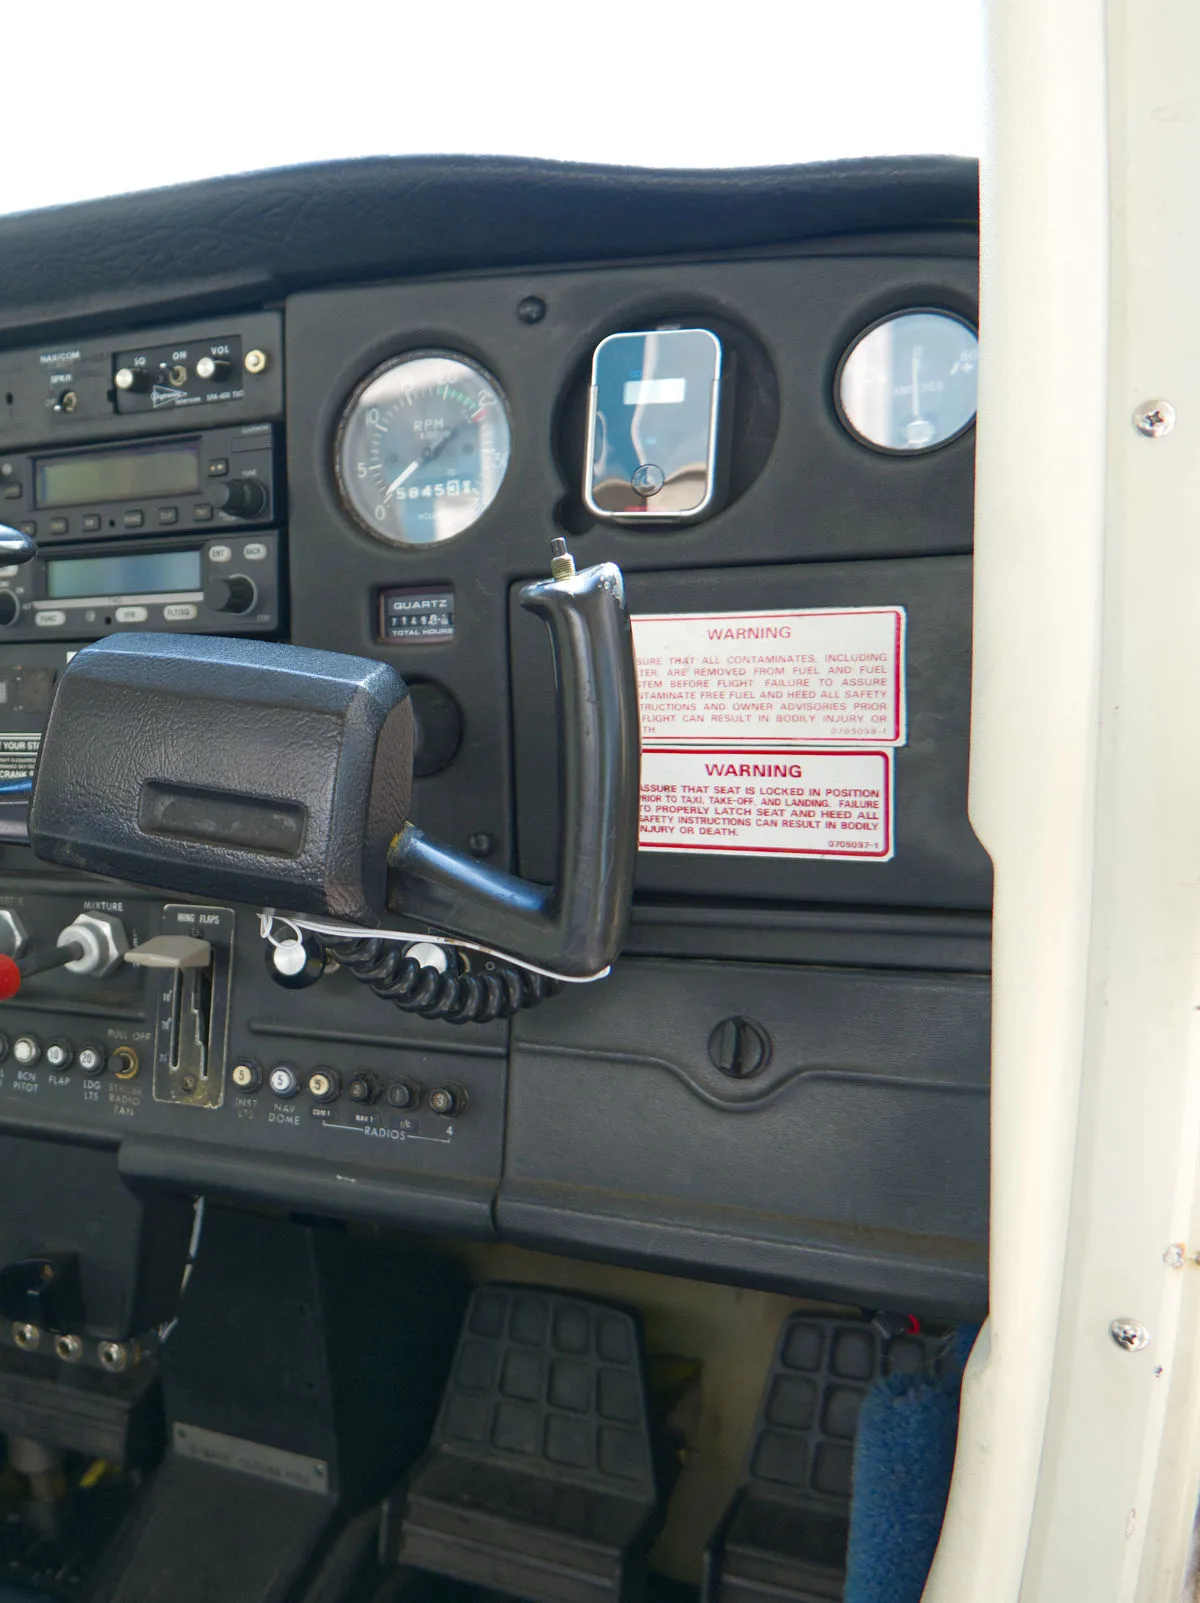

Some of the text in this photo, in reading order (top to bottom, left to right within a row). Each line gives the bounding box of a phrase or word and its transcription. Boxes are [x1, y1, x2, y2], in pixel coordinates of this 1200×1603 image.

[172, 351, 187, 360] ON
[211, 346, 230, 355] VOL
[366, 409, 379, 424] 10
[414, 419, 444, 431] RPM
[358, 463, 367, 478] 5
[375, 505, 385, 520] 0
[394, 600, 448, 610] QUARTZ
[707, 626, 792, 641] WARNING
[825, 653, 887, 662] INCLUDING
[667, 668, 687, 676] ARE
[694, 668, 746, 676] REMOVED
[754, 667, 785, 675] FROM
[793, 666, 820, 674] FUEL
[828, 666, 852, 674] AND
[860, 666, 887, 674] FUEL
[670, 680, 709, 688] BEFORE
[718, 679, 753, 687] FLIGHT
[765, 679, 810, 687] FAILURE
[819, 678, 833, 686] TO
[841, 678, 887, 686] ASSURE
[729, 691, 755, 699] FUEL
[844, 690, 887, 698] SAFETY
[780, 702, 847, 710] ADVISORIES
[854, 702, 887, 710] PRIOR
[642, 714, 676, 722] FLIGHT
[711, 714, 752, 722] RESULT
[776, 714, 815, 722] BODILY
[823, 714, 864, 722] INJURY
[871, 714, 887, 722] OR
[3, 741, 25, 749] YOUR
[0, 770, 27, 778] CRANK
[705, 763, 802, 778] WARNING
[682, 785, 709, 793] THAT
[713, 786, 740, 794] SEAT
[745, 787, 755, 795] IS
[760, 787, 804, 796] LOCKED
[808, 788, 820, 796] IN
[825, 788, 880, 798] POSITION
[666, 795, 677, 803] TO
[761, 798, 781, 806] AND
[838, 800, 879, 808] FAILURE
[656, 805, 709, 814] PROPERLY
[714, 807, 752, 815] LATCH
[756, 808, 786, 816] SEAT
[790, 810, 816, 818] AND
[821, 811, 852, 819] HEED
[857, 812, 879, 820] ALL
[678, 816, 879, 830] INSTRUCTIONS CAN RESULT IN BODILY
[828, 840, 879, 849] 0705097-1
[84, 901, 123, 912] MIXTURE
[178, 913, 220, 924] WING FLAPS
[108, 1028, 151, 1041] PULL OFF
[50, 1049, 59, 1060] 10
[82, 1053, 92, 1064] 20
[17, 1071, 36, 1081] BCN
[49, 1075, 70, 1086] FLAP
[239, 1070, 245, 1081] 5
[277, 1076, 283, 1086] 5
[13, 1081, 39, 1092] PITOT
[83, 1080, 101, 1090] LDG
[354, 1085, 361, 1095] 2
[84, 1090, 99, 1101] LTS
[109, 1093, 140, 1106] RADIO
[437, 1095, 443, 1106] 3
[274, 1104, 296, 1112] NAV
[269, 1112, 300, 1125] DOME
[364, 1126, 406, 1140] RADIOS
[446, 1125, 454, 1136] 4
